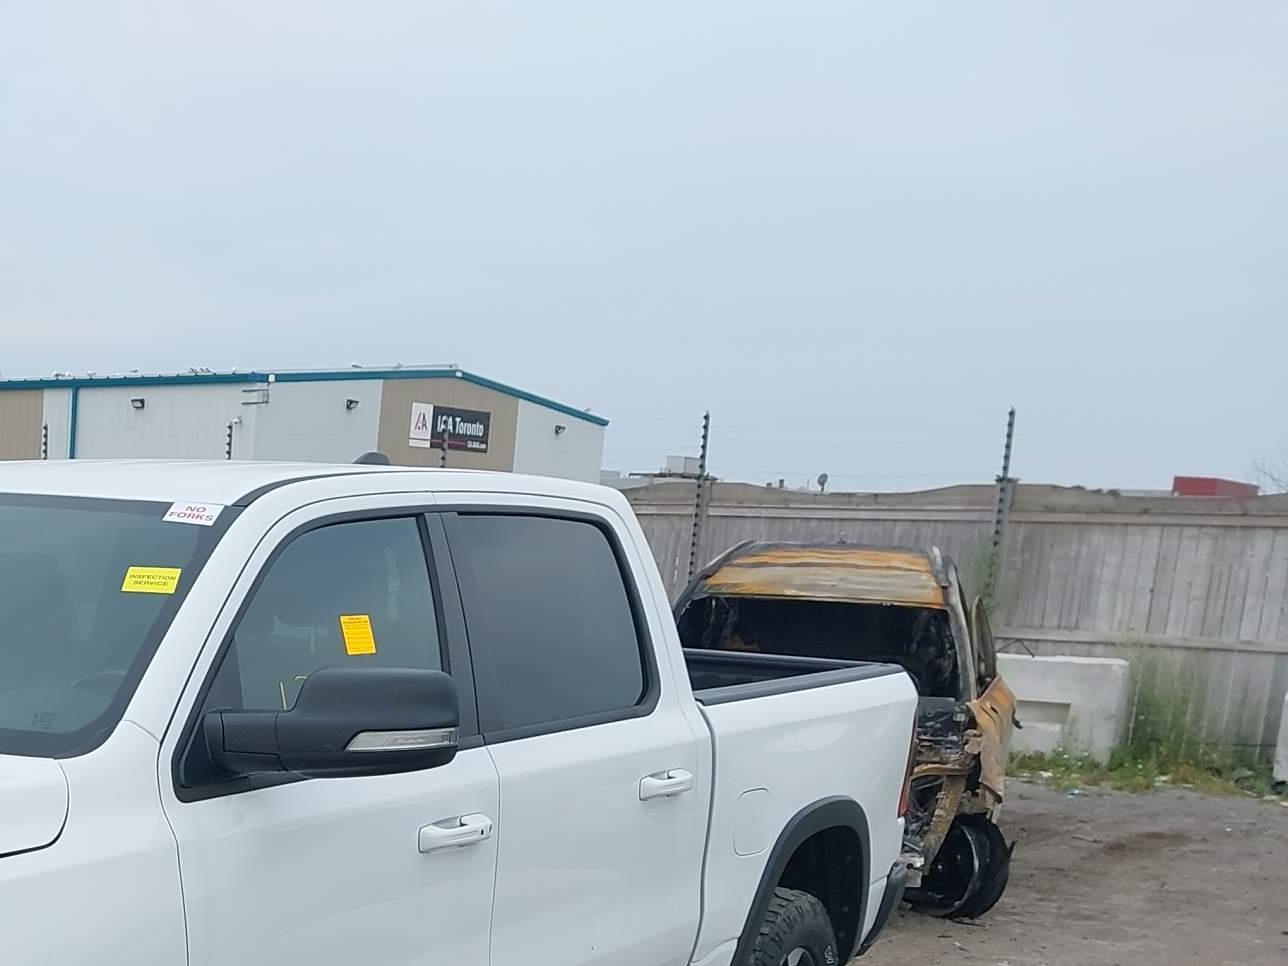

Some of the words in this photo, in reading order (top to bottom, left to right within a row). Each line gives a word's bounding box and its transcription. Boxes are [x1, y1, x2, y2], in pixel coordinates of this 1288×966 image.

[455, 416, 484, 437] Toronto
[185, 505, 207, 513] NO
[168, 511, 214, 522] FORKS
[128, 573, 177, 581] INSPECTION
